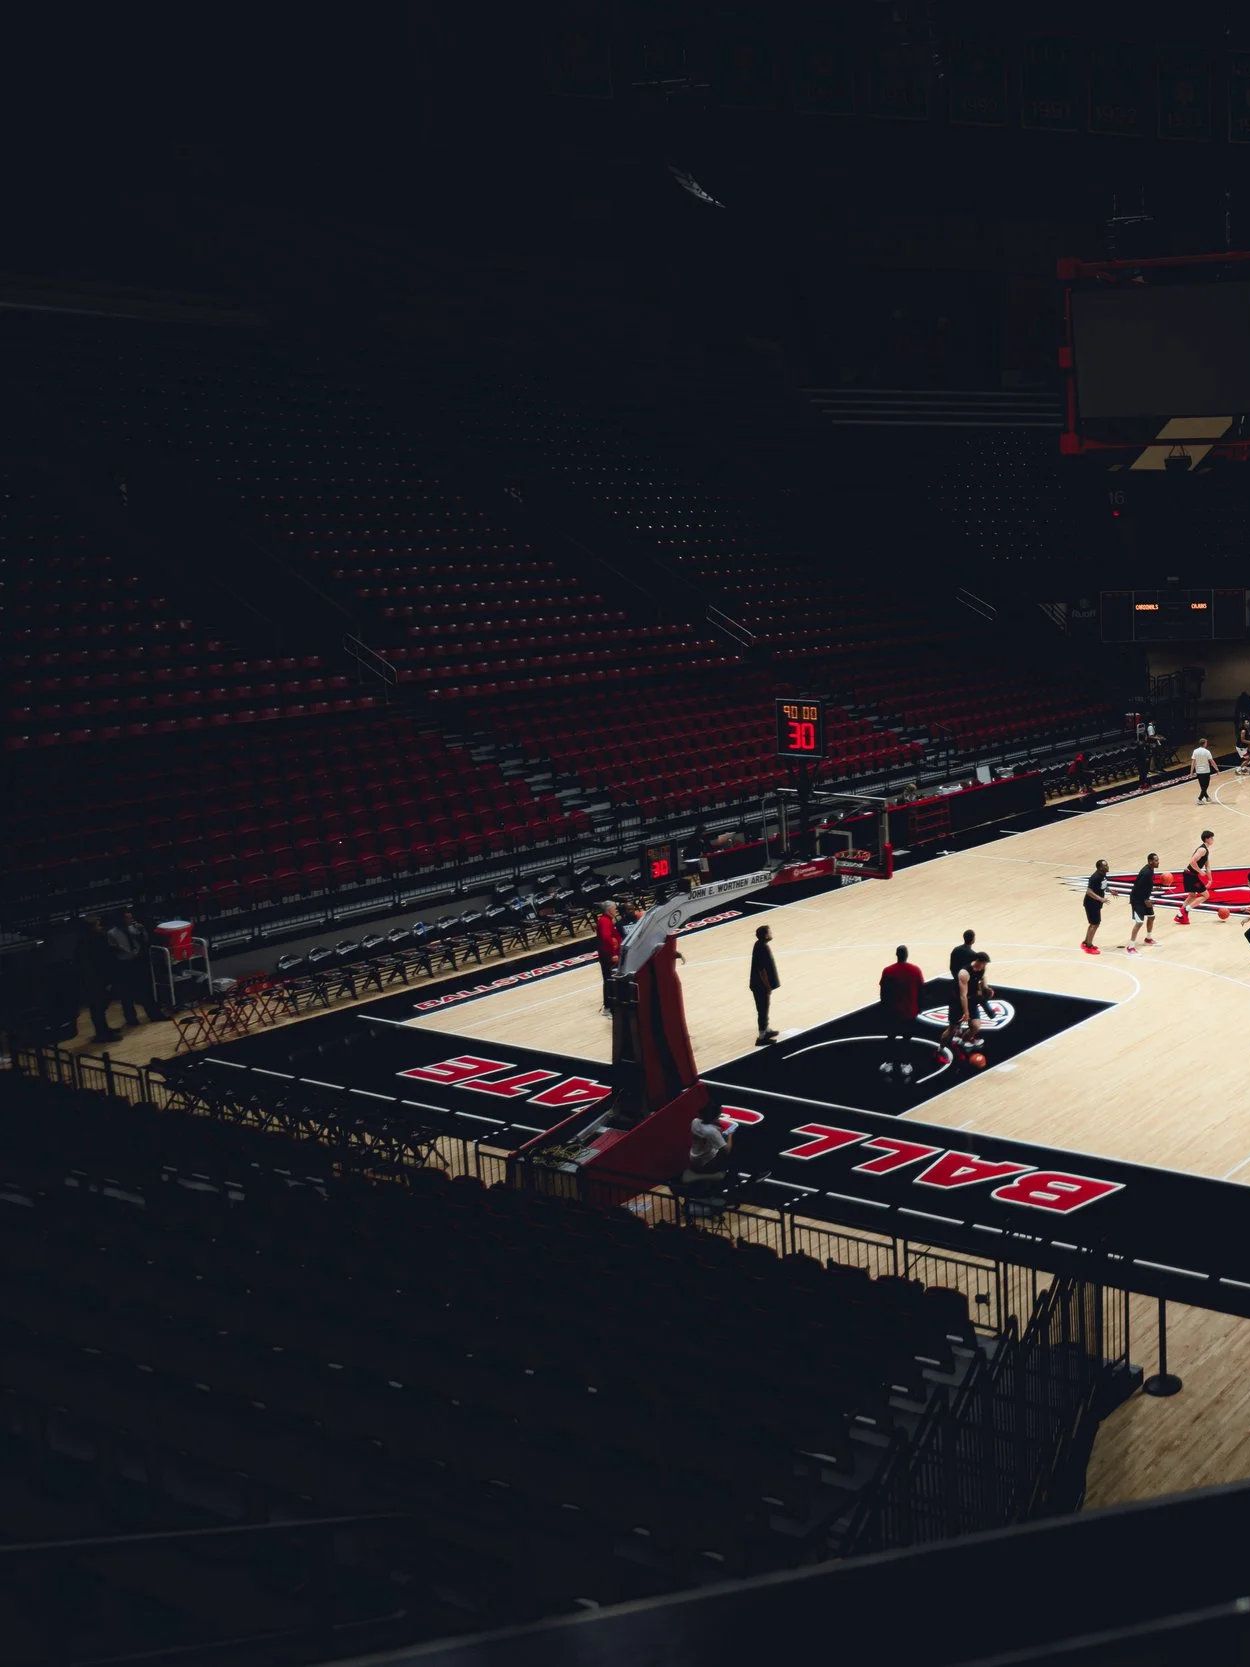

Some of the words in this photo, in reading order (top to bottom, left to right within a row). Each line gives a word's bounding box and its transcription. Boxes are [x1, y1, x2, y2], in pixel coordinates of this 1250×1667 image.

[787, 721, 815, 750] 30
[651, 859, 671, 879] 30
[688, 888, 706, 900] JOHN
[717, 878, 748, 893] WORTHEN
[779, 1122, 1126, 1214] BALL
